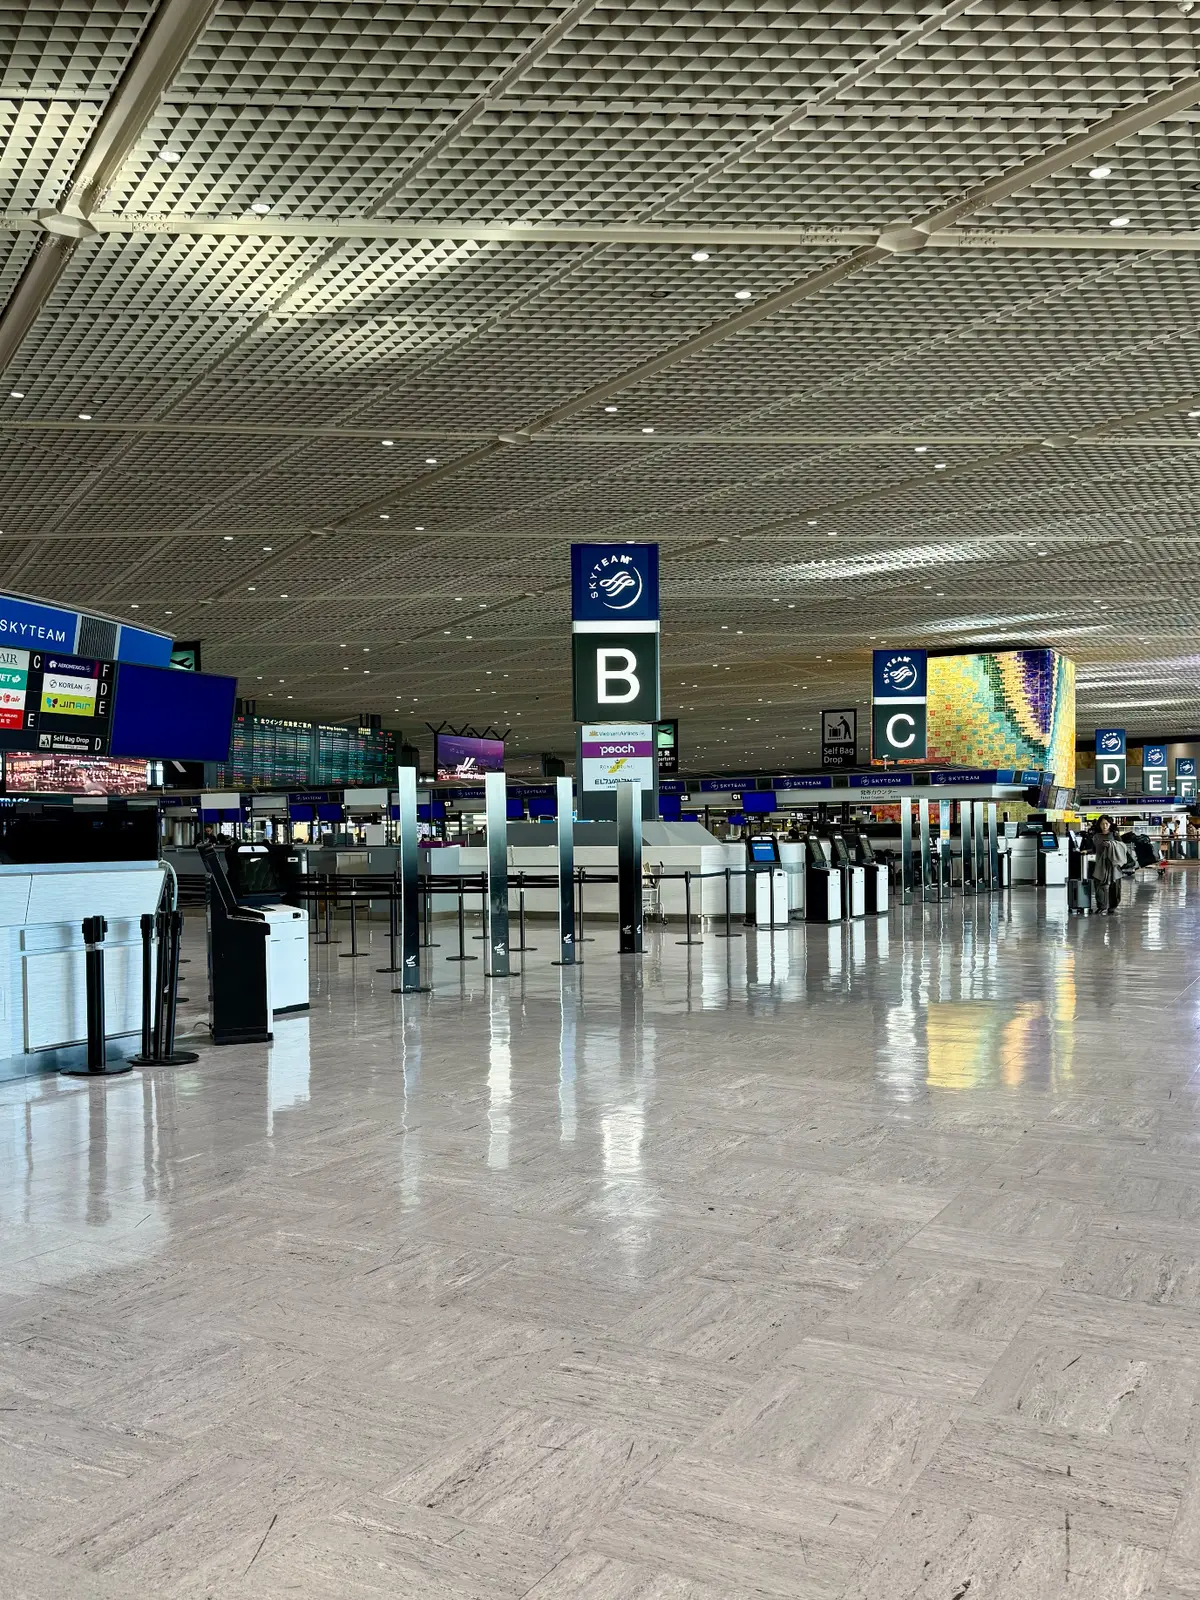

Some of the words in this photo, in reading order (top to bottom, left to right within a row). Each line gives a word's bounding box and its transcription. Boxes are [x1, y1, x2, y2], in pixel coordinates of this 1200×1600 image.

[589, 554, 633, 599] SKYTEAM
[0, 619, 66, 642] SKYTEAM
[33, 655, 41, 669] C
[102, 663, 110, 678] F
[596, 647, 641, 704] B
[59, 682, 83, 690] KOREAN
[100, 682, 108, 696] D
[98, 701, 106, 715] E
[27, 713, 35, 727] E
[885, 713, 916, 748] C
[53, 734, 65, 742] Self
[65, 736, 75, 744] Bag
[75, 737, 89, 745] Drop
[94, 738, 102, 751] D
[600, 743, 635, 756] peach
[823, 747, 838, 755] Self
[839, 747, 854, 756] Bag
[823, 756, 843, 764] Drop
[1103, 763, 1121, 785] D
[1149, 774, 1162, 791] E
[1181, 782, 1193, 797] F
